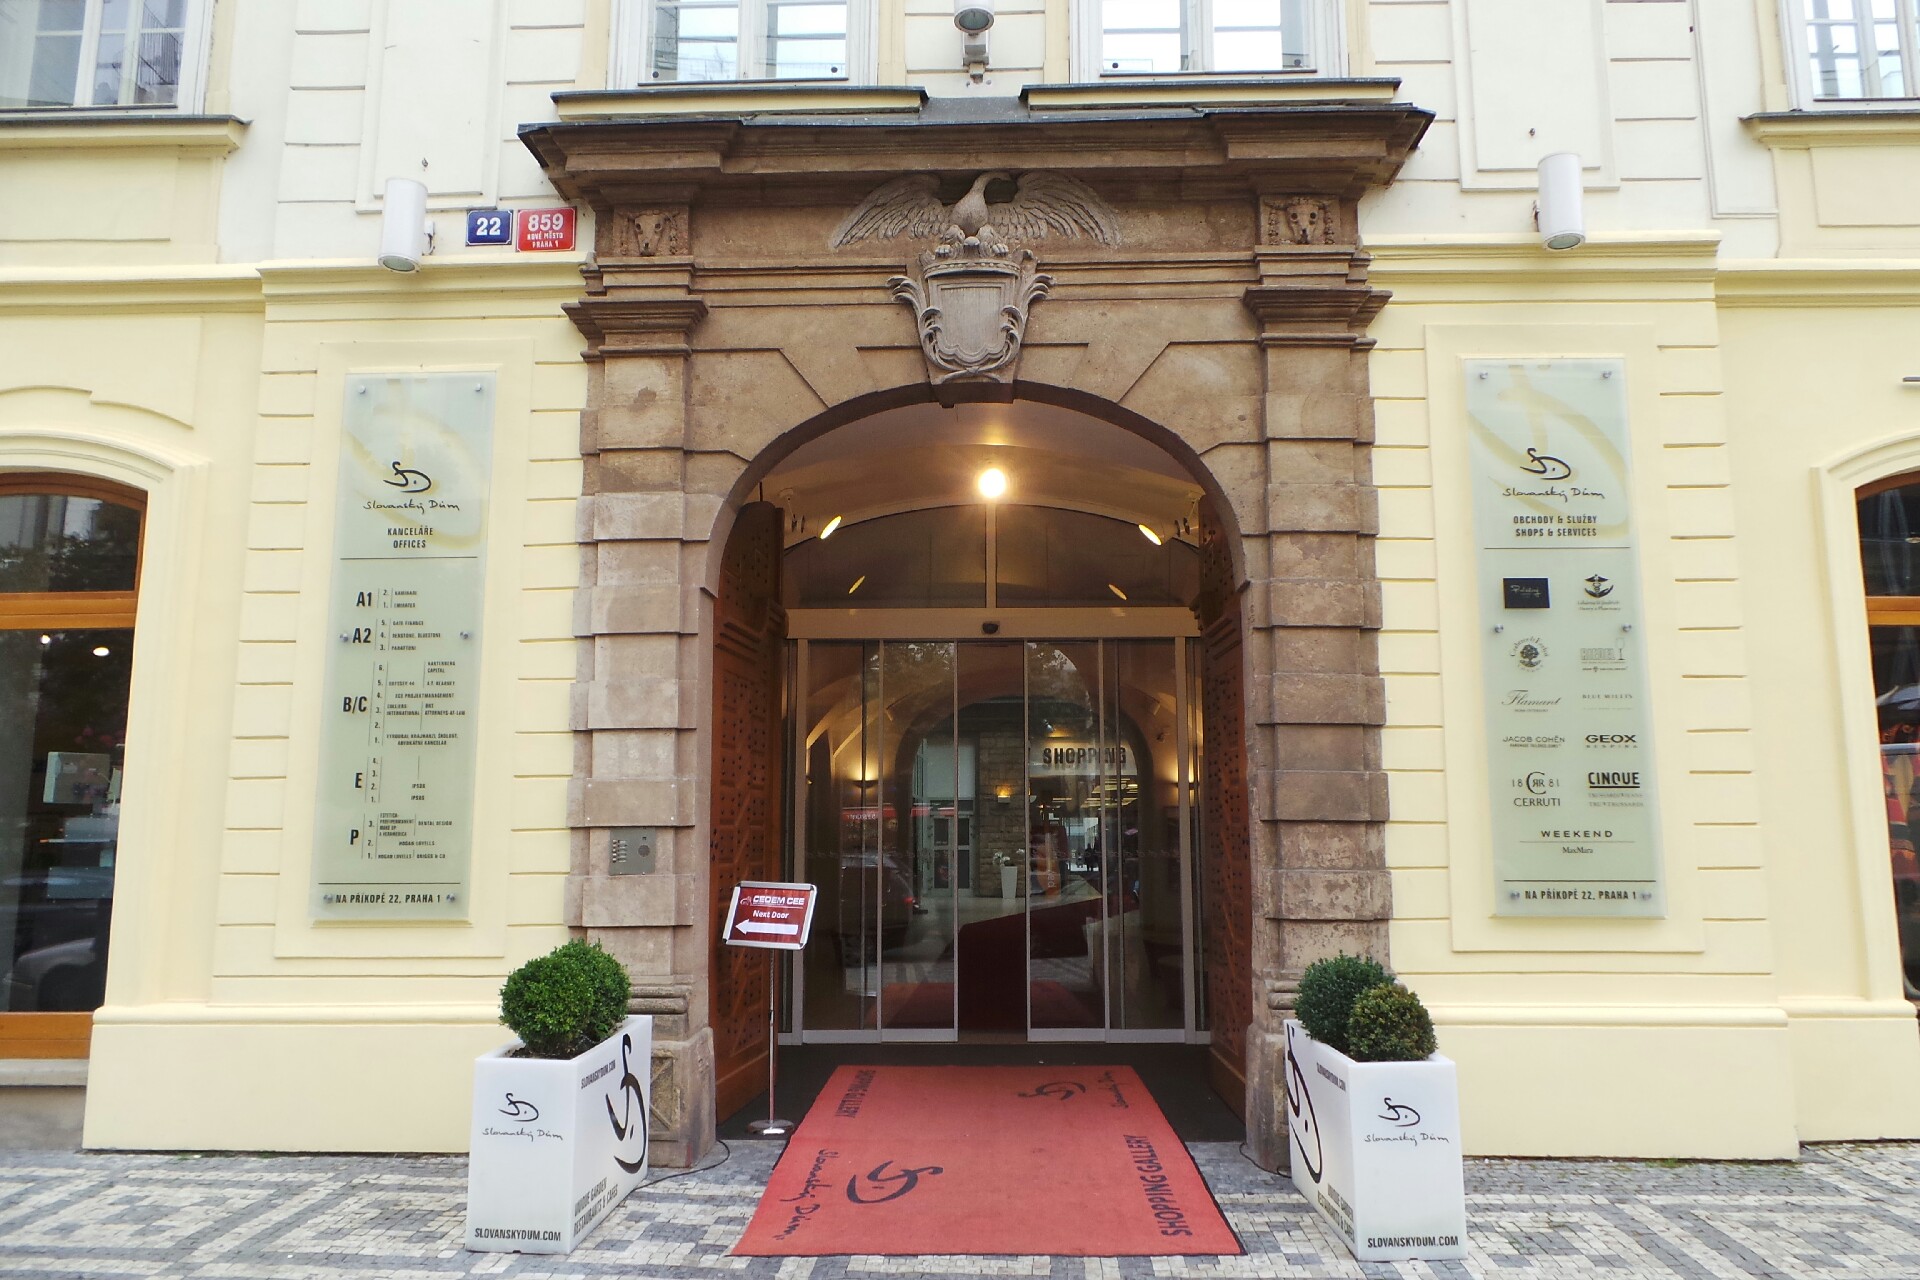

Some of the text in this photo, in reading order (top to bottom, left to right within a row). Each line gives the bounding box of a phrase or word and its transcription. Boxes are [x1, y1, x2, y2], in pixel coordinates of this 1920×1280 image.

[476, 218, 502, 236] 22
[528, 214, 564, 232] 859
[527, 232, 542, 240] NOVÉ
[1514, 516, 1554, 524] OBCHODY
[1567, 514, 1598, 524] SLUŽBY
[1558, 528, 1597, 536] SERVICES
[394, 540, 426, 548] OFFICES
[356, 592, 372, 606] A1
[352, 628, 371, 643] A2
[343, 696, 368, 714] B/C
[1586, 735, 1636, 743] GEOX
[1043, 747, 1126, 764] SHOPPING
[355, 773, 362, 788] E
[1588, 772, 1640, 785] CINQUE
[1514, 798, 1560, 806] CERRUTI
[350, 830, 359, 845] P
[336, 894, 347, 903] NA
[389, 894, 402, 904] 22,
[405, 894, 434, 903] PRAHA
[436, 894, 440, 903] 1
[1525, 890, 1537, 900] NA
[1582, 891, 1596, 900] 22,
[1599, 890, 1628, 900] PRAHA
[1632, 891, 1636, 900] 1
[786, 898, 805, 906] CEE
[753, 910, 770, 918] Next
[1123, 1135, 1192, 1236] SHOPPING GALLERY
[475, 1228, 561, 1242] SLOVANSKYDUM.COM
[1368, 1236, 1458, 1248] SLOVANSKYDUM.COM
